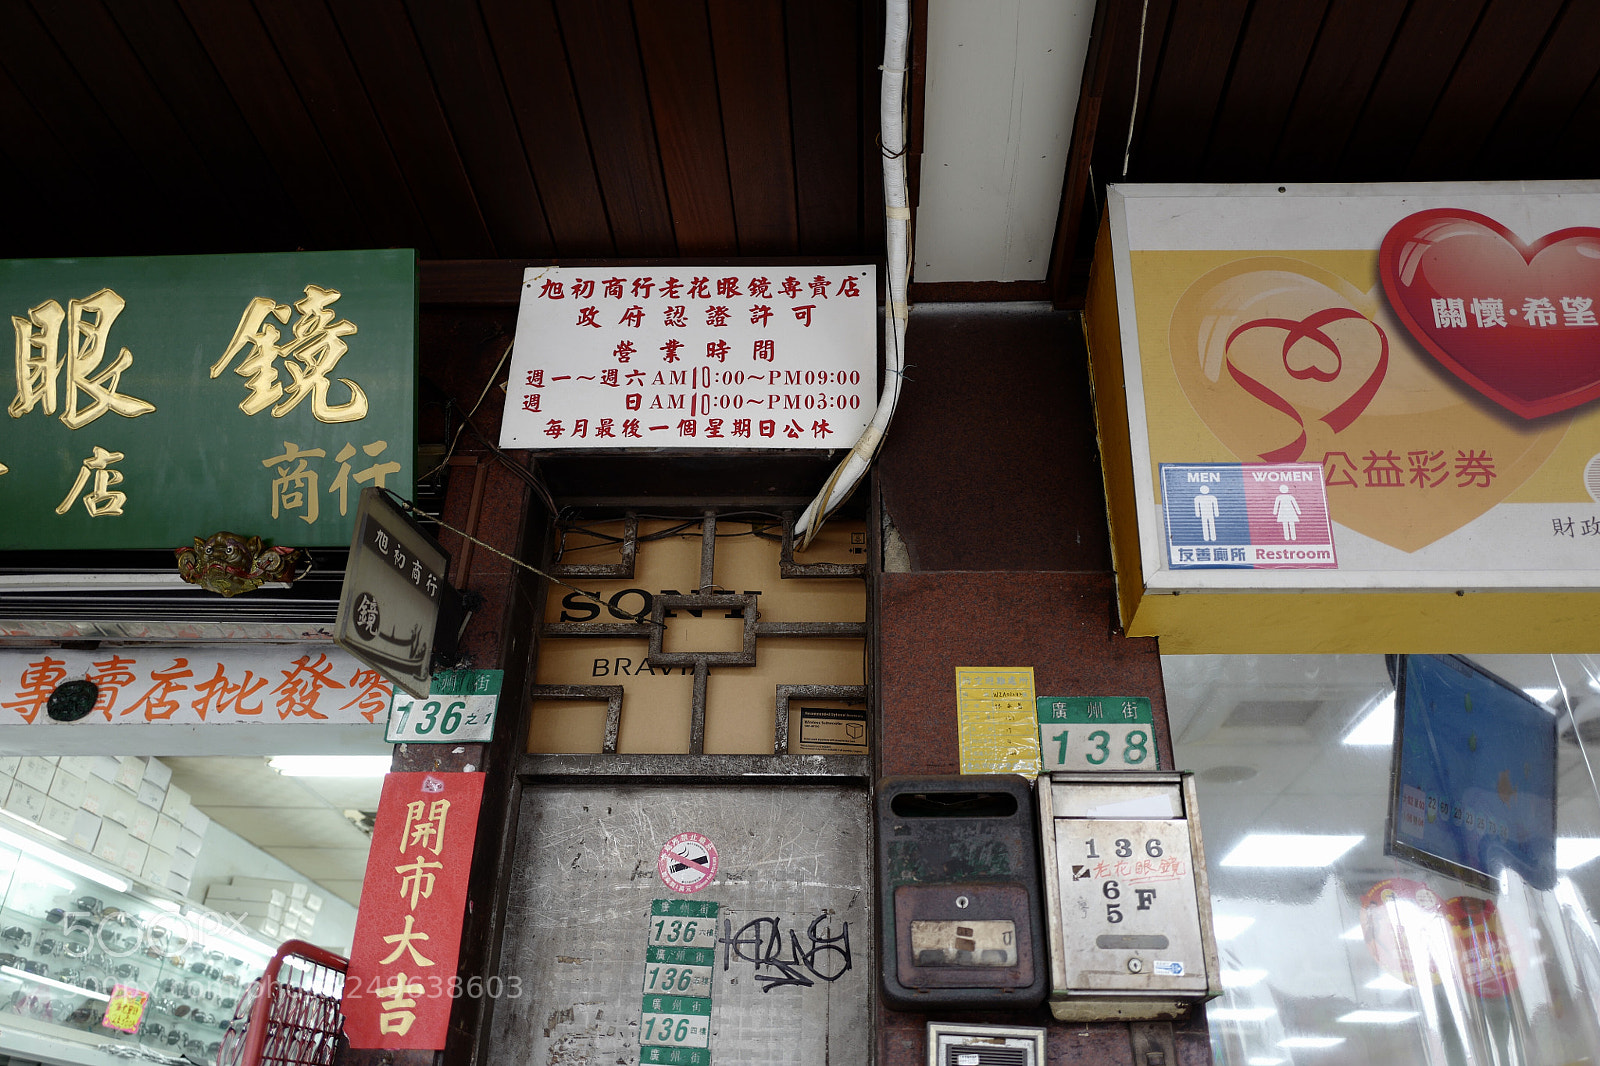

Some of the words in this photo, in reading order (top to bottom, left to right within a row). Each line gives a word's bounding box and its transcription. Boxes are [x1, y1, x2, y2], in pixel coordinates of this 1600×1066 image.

[576, 304, 817, 329] 政府認證許可
[8, 284, 369, 430] 眼鏡
[613, 339, 775, 363] 營業時間
[543, 418, 834, 440] 每月最後一個星期日公休
[1187, 472, 1221, 483] MEN
[1251, 471, 1314, 482] WOMEN
[1323, 449, 1497, 489] 公益彩券
[262, 440, 401, 525] 商行
[374, 529, 438, 597] 旭初商行
[1177, 547, 1246, 562] 友善廁所
[1255, 548, 1331, 560] Restroom
[357, 594, 379, 636] 鏡
[1052, 701, 1138, 719] 廣州街
[1052, 730, 1148, 765] 138
[1085, 839, 1163, 858] 136
[1093, 857, 1186, 880] 老花眼鏡
[660, 901, 710, 914] 廣州街
[1135, 889, 1157, 910] F
[379, 799, 451, 1037] 開市大吉
[1106, 904, 1123, 923] 5
[656, 949, 705, 963] 廣州街
[652, 998, 702, 1012] 廣州街
[650, 1050, 701, 1065] 廣州街
